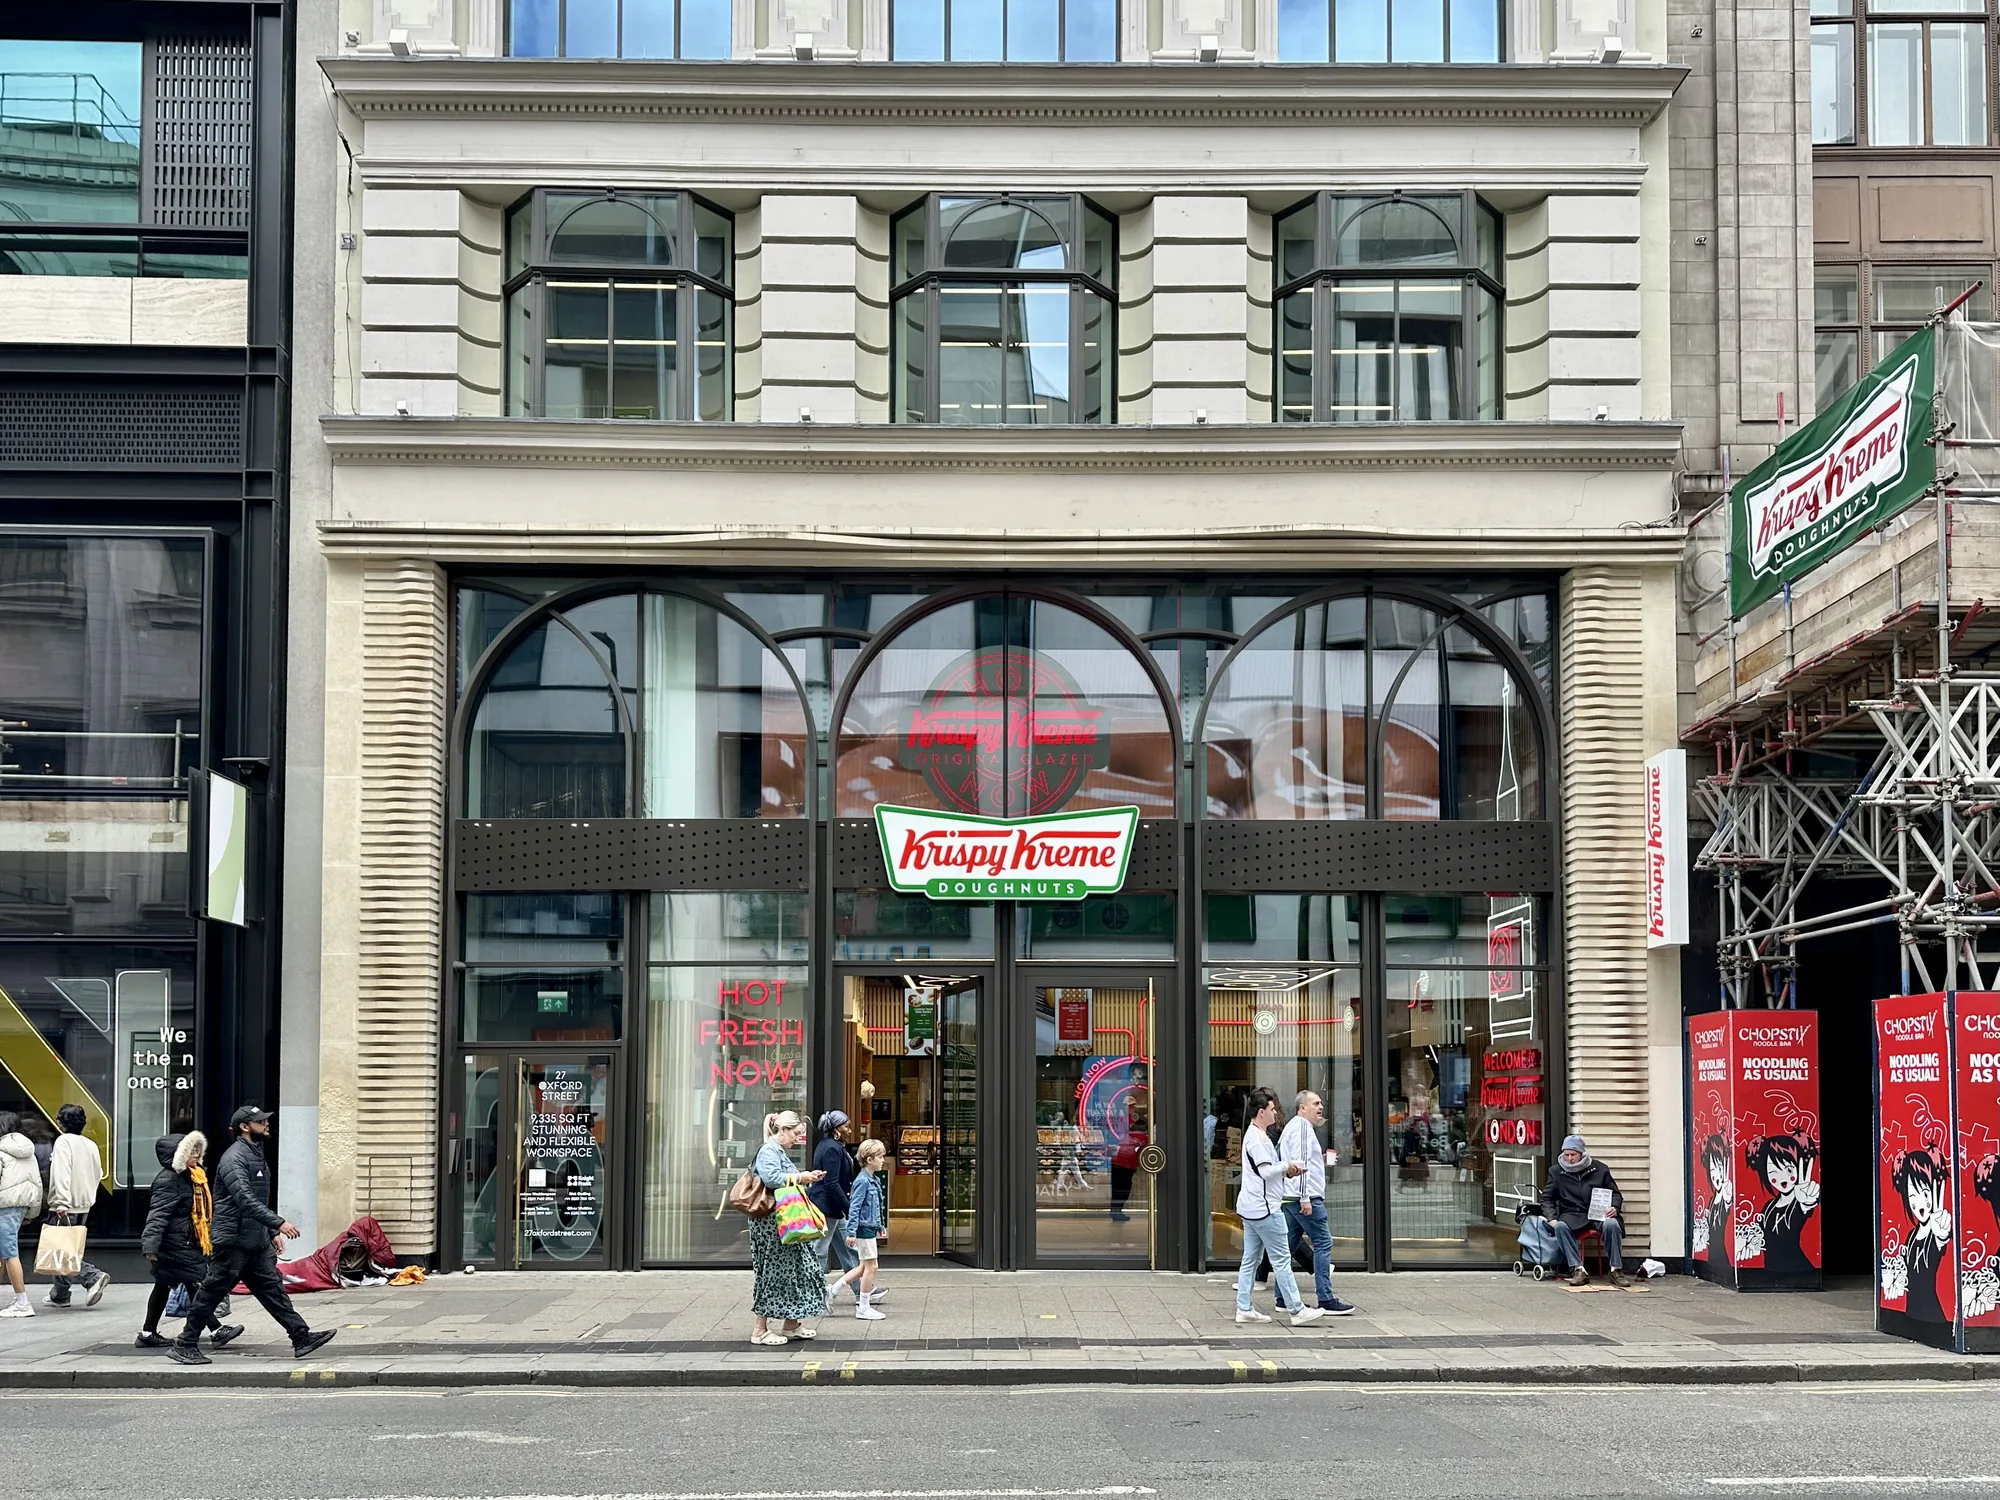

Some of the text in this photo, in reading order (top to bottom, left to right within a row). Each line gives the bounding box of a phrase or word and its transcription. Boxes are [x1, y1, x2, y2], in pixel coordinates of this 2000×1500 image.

[1756, 397, 1902, 553] Krispy Kreme
[1774, 490, 1869, 564] DOUGHNUTS
[906, 709, 1104, 753] Krispy Kreme
[915, 753, 1094, 765] ORIGINA GLAZED
[899, 829, 1121, 876] Krispy Kreme
[1647, 766, 1665, 938] Krispy Kreme
[938, 883, 1075, 894] DOUGHNUTS
[718, 979, 787, 1006] HOT
[1884, 1010, 1938, 1038] CHOPSTIX
[160, 1027, 187, 1043] We
[700, 1019, 803, 1046] FRESH
[1694, 1025, 1726, 1046] CHOPSTIX
[1739, 1024, 1811, 1047] CHOPSTIX
[133, 1050, 171, 1066] the
[1484, 1050, 1527, 1070] WELCOME
[1698, 1058, 1726, 1070] NOODLING
[1743, 1058, 1808, 1069] NOODLING
[1889, 1053, 1939, 1068] NOODLING
[555, 1071, 566, 1080] 27
[710, 1060, 793, 1086] NOW
[1074, 1057, 1106, 1099] HOT NOW
[1699, 1069, 1726, 1081] AS USUAL!
[1743, 1070, 1809, 1080] AS USUAL!
[1890, 1068, 1940, 1083] AS USUAL!
[1970, 1069, 1993, 1083] AS
[127, 1076, 165, 1089] one
[538, 1081, 583, 1090] OXFORD
[541, 1092, 579, 1101] STREET
[530, 1113, 590, 1124] 9,335 SQ FT
[532, 1125, 588, 1135] STUNNING
[1485, 1118, 1536, 1145] LONDON
[523, 1137, 596, 1146] AND FLEXIBLE
[526, 1148, 593, 1157] WORKSPACE
[1036, 1182, 1073, 1197] AILY
[524, 1229, 592, 1237] 27oxfordstreet.com
